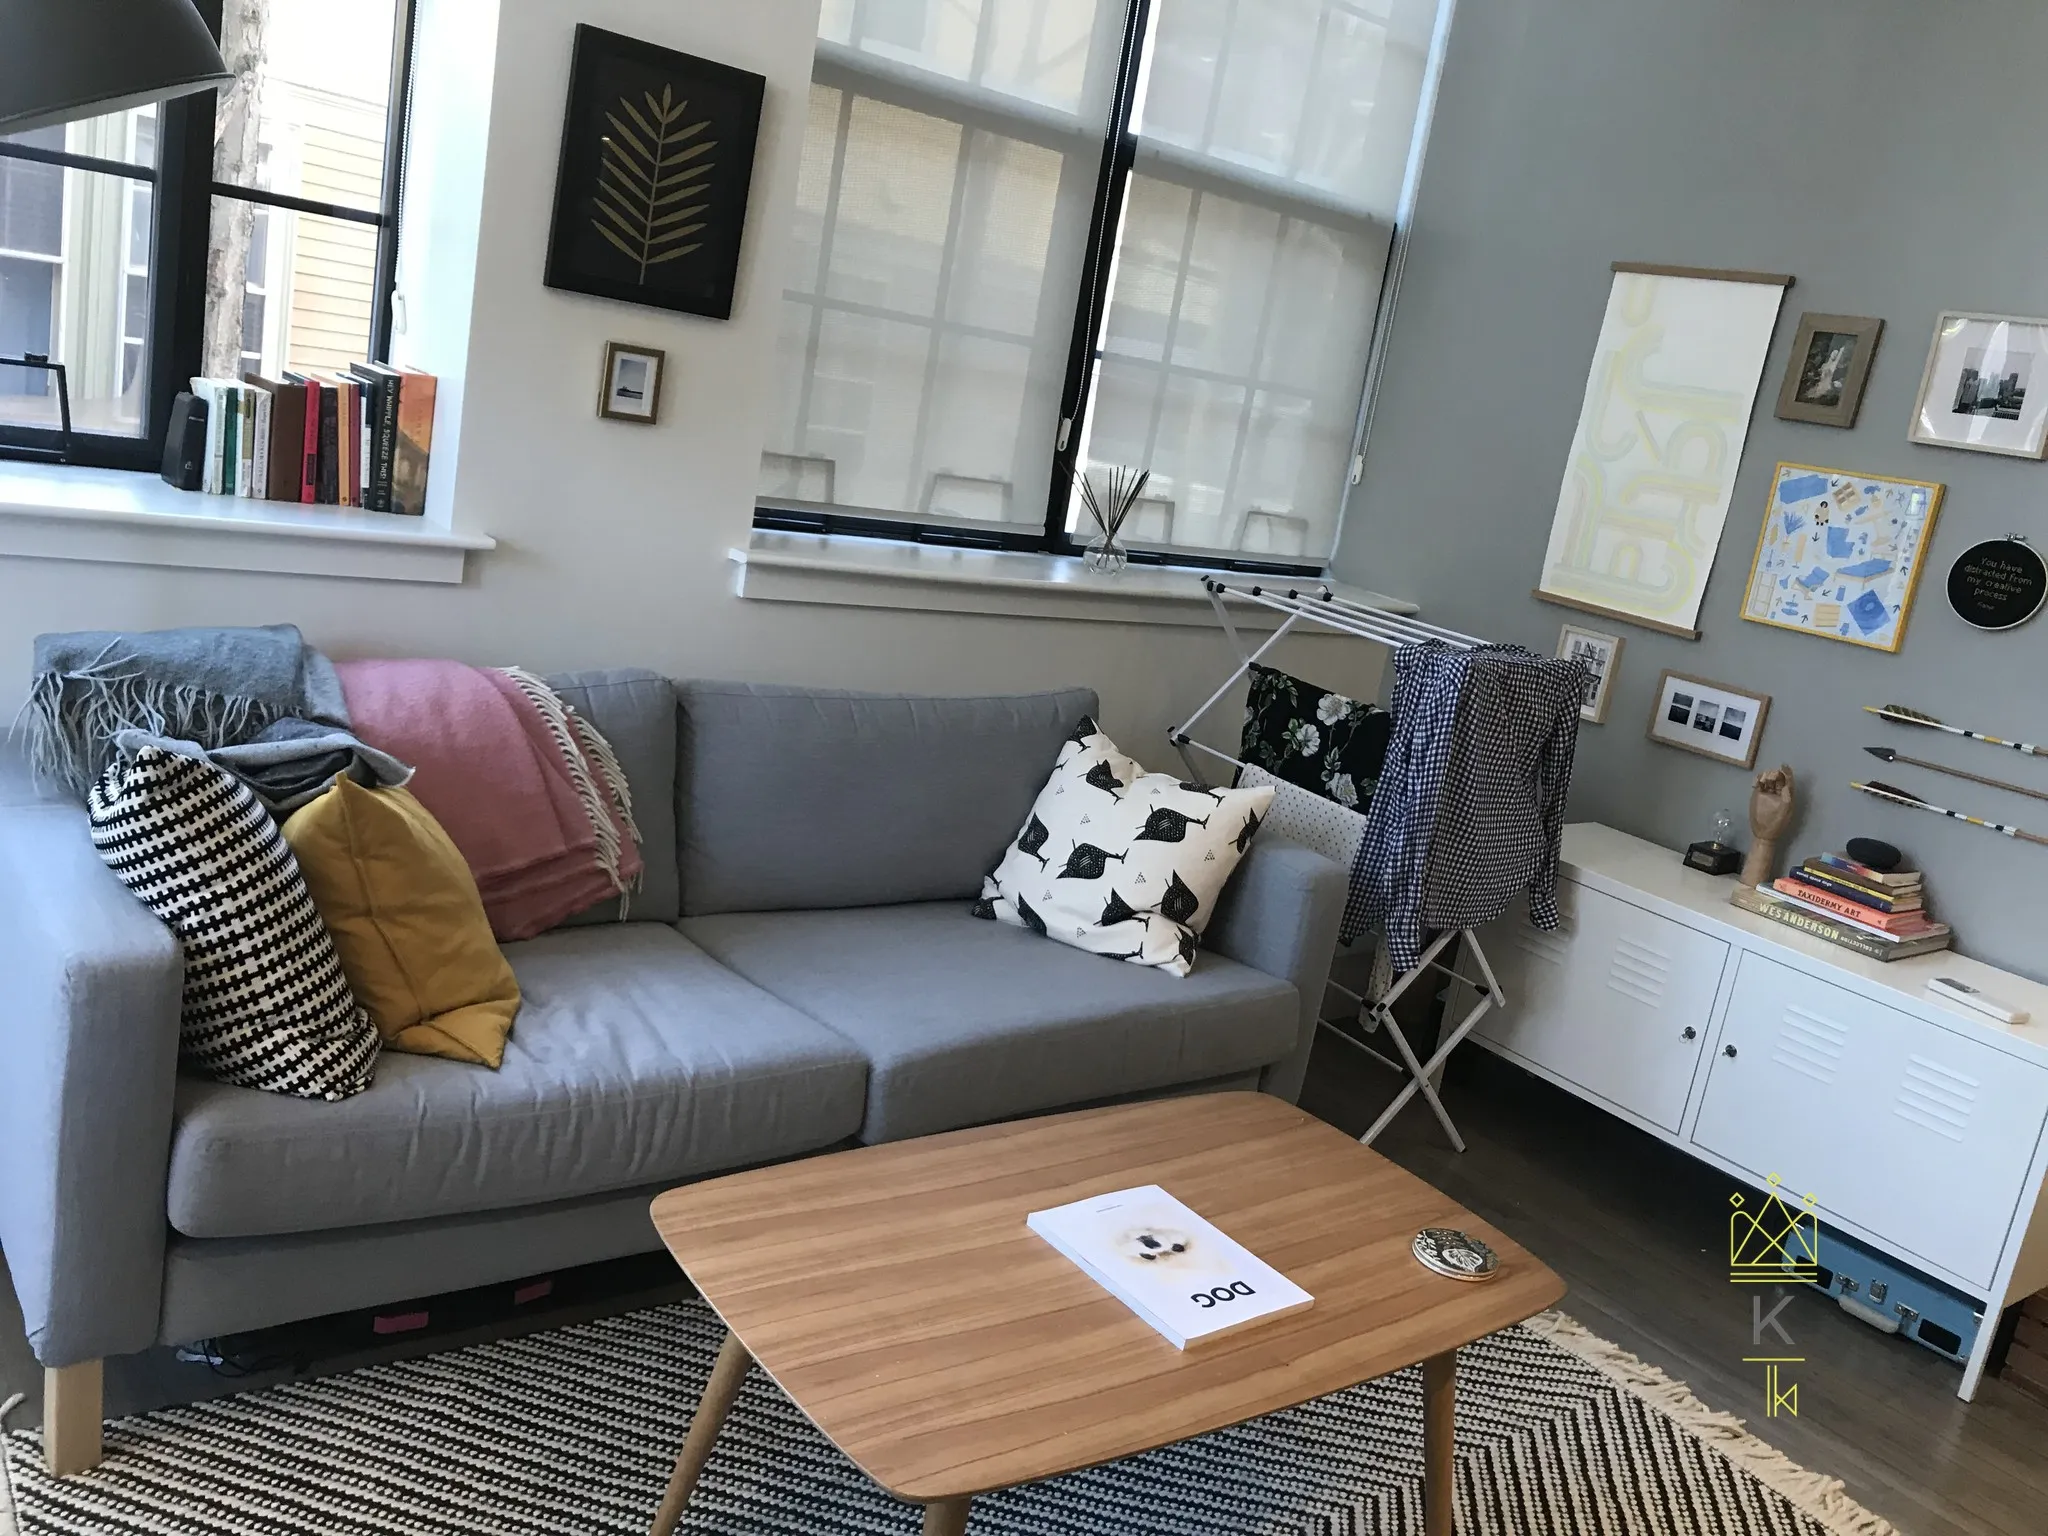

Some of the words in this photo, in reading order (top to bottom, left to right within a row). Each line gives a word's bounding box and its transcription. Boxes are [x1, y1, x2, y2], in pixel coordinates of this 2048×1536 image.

[387, 380, 395, 394] HEY
[381, 428, 391, 461] SQUEEZE
[1964, 564, 2007, 580] distracted
[2009, 573, 2033, 586] from
[1981, 557, 1998, 568] You
[2000, 560, 2023, 574] have
[1966, 576, 1981, 586] my
[1985, 580, 2022, 594] creative
[1973, 587, 2008, 601] process
[1797, 889, 1844, 911] TAXIDERMY
[1844, 907, 1862, 918] ART
[1759, 902, 1782, 919] WES
[1783, 911, 1840, 941] ANDERSON
[1190, 1280, 1257, 1309] DOG
